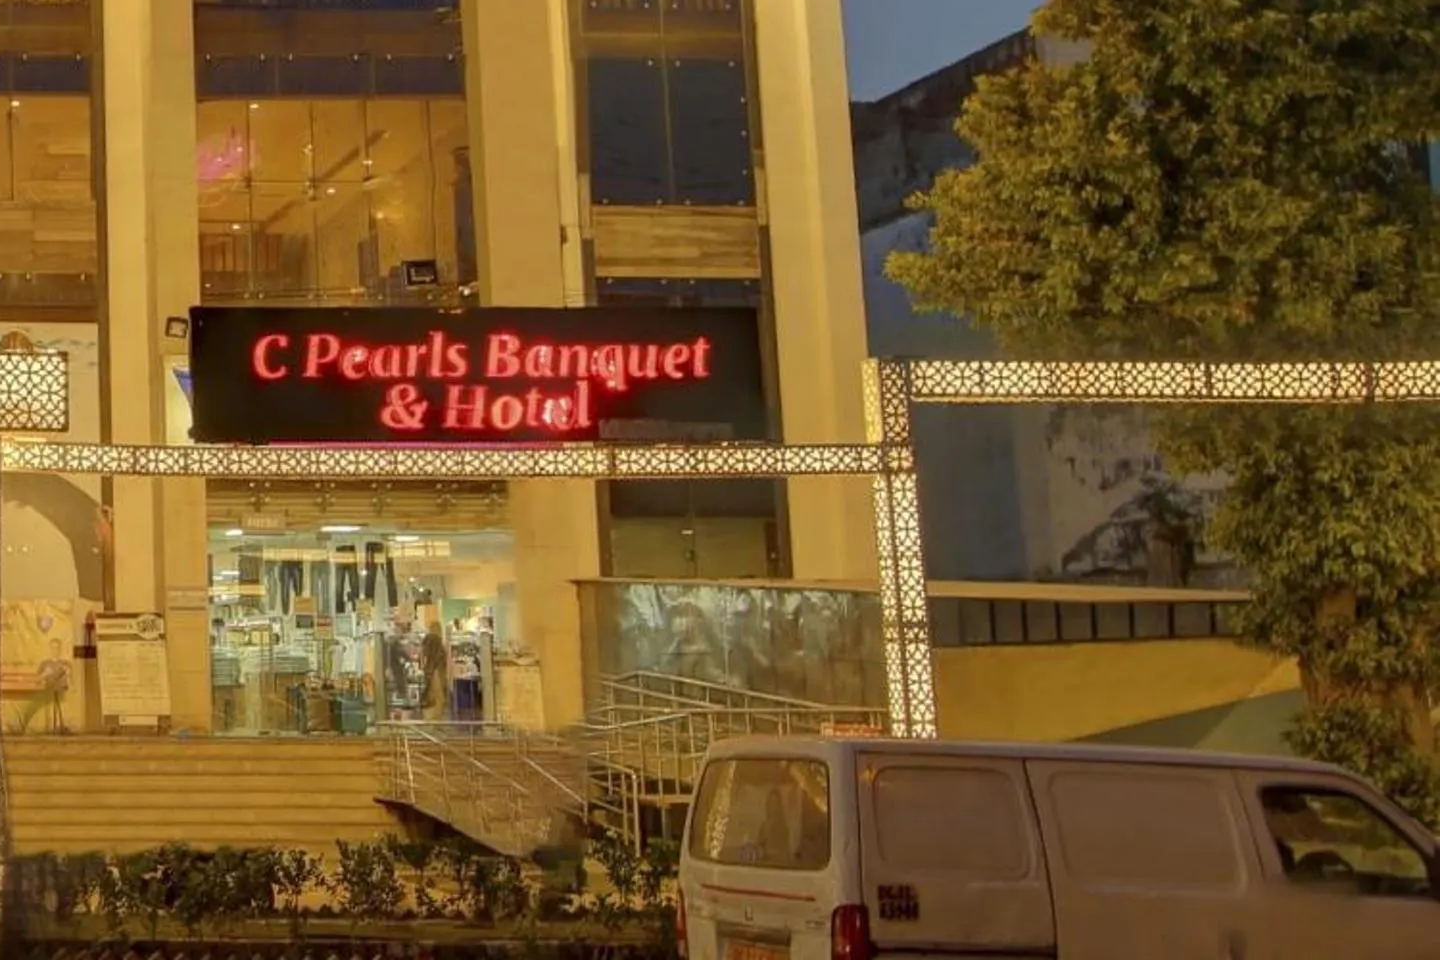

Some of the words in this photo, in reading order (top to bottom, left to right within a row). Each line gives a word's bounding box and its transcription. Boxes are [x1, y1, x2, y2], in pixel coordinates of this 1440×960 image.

[253, 334, 287, 381] C
[304, 330, 468, 380] Pearls
[487, 332, 711, 391] Banquet
[379, 385, 426, 430] &
[442, 380, 592, 431] Hotel
